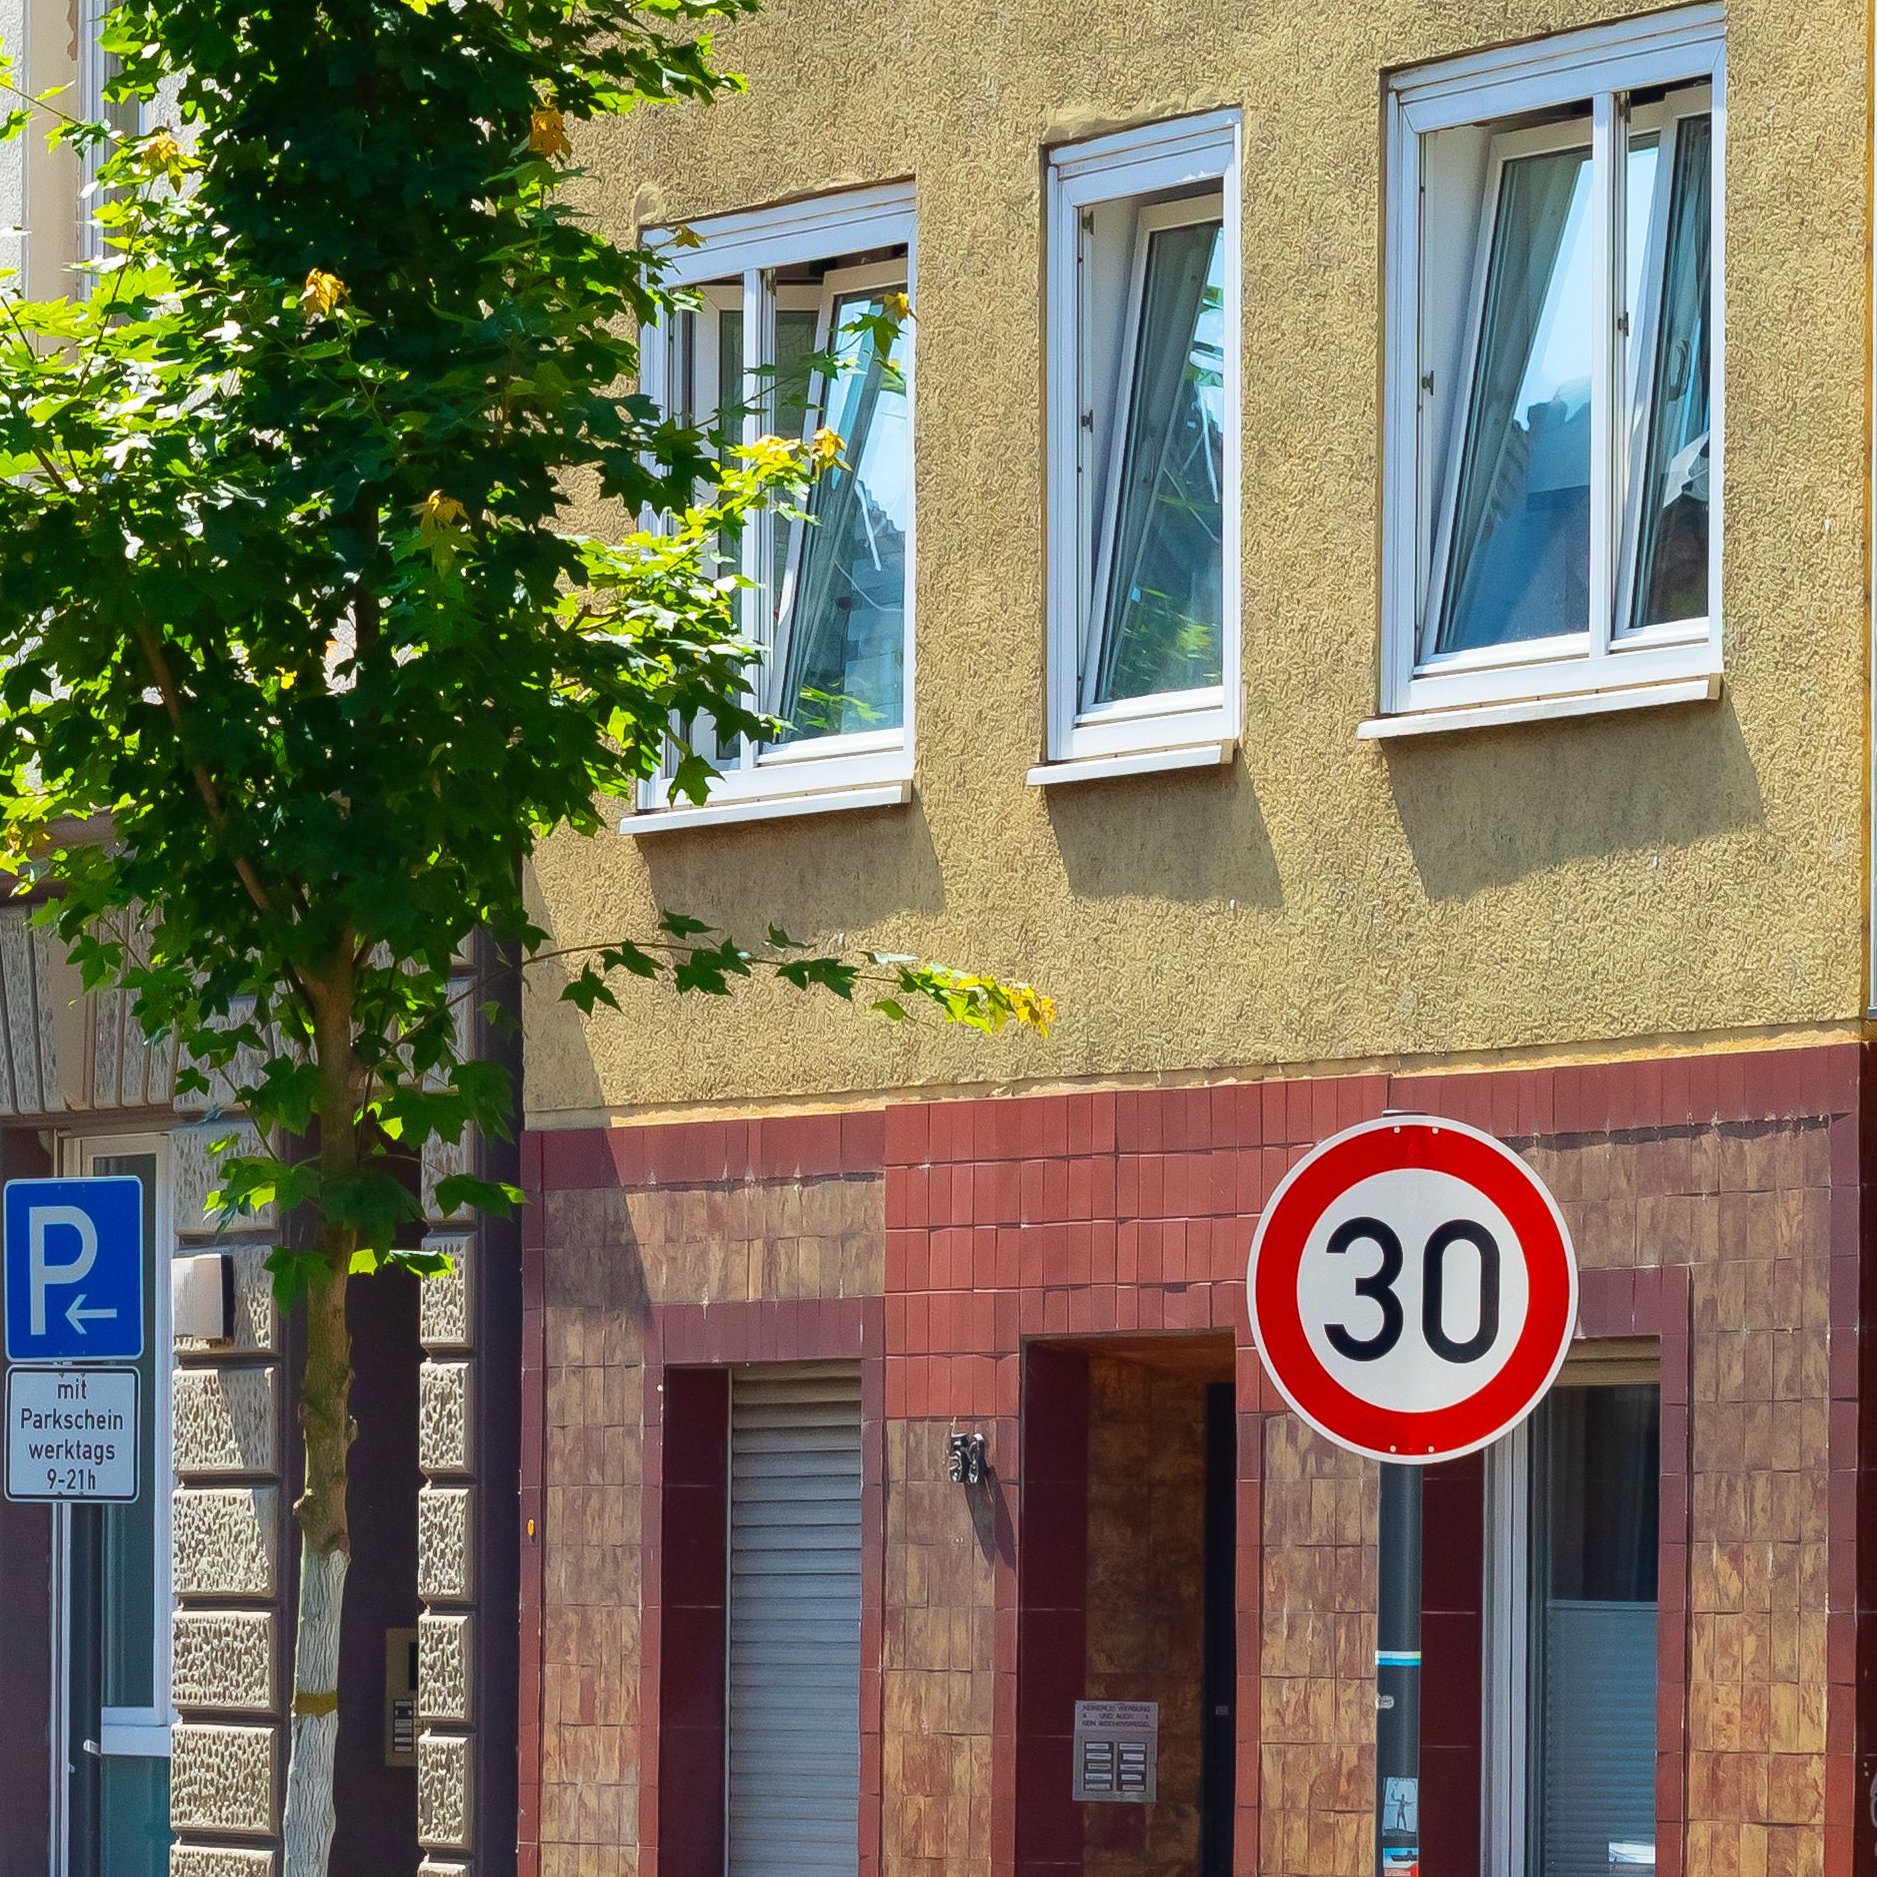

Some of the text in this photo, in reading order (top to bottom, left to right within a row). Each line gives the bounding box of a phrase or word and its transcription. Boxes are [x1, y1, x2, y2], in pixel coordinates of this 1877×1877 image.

[28, 1205, 98, 1335] P
[1324, 1216, 1500, 1364] 30
[57, 1379, 87, 1400] mit
[21, 1408, 124, 1431] Parkschein
[28, 1440, 116, 1466] werktags
